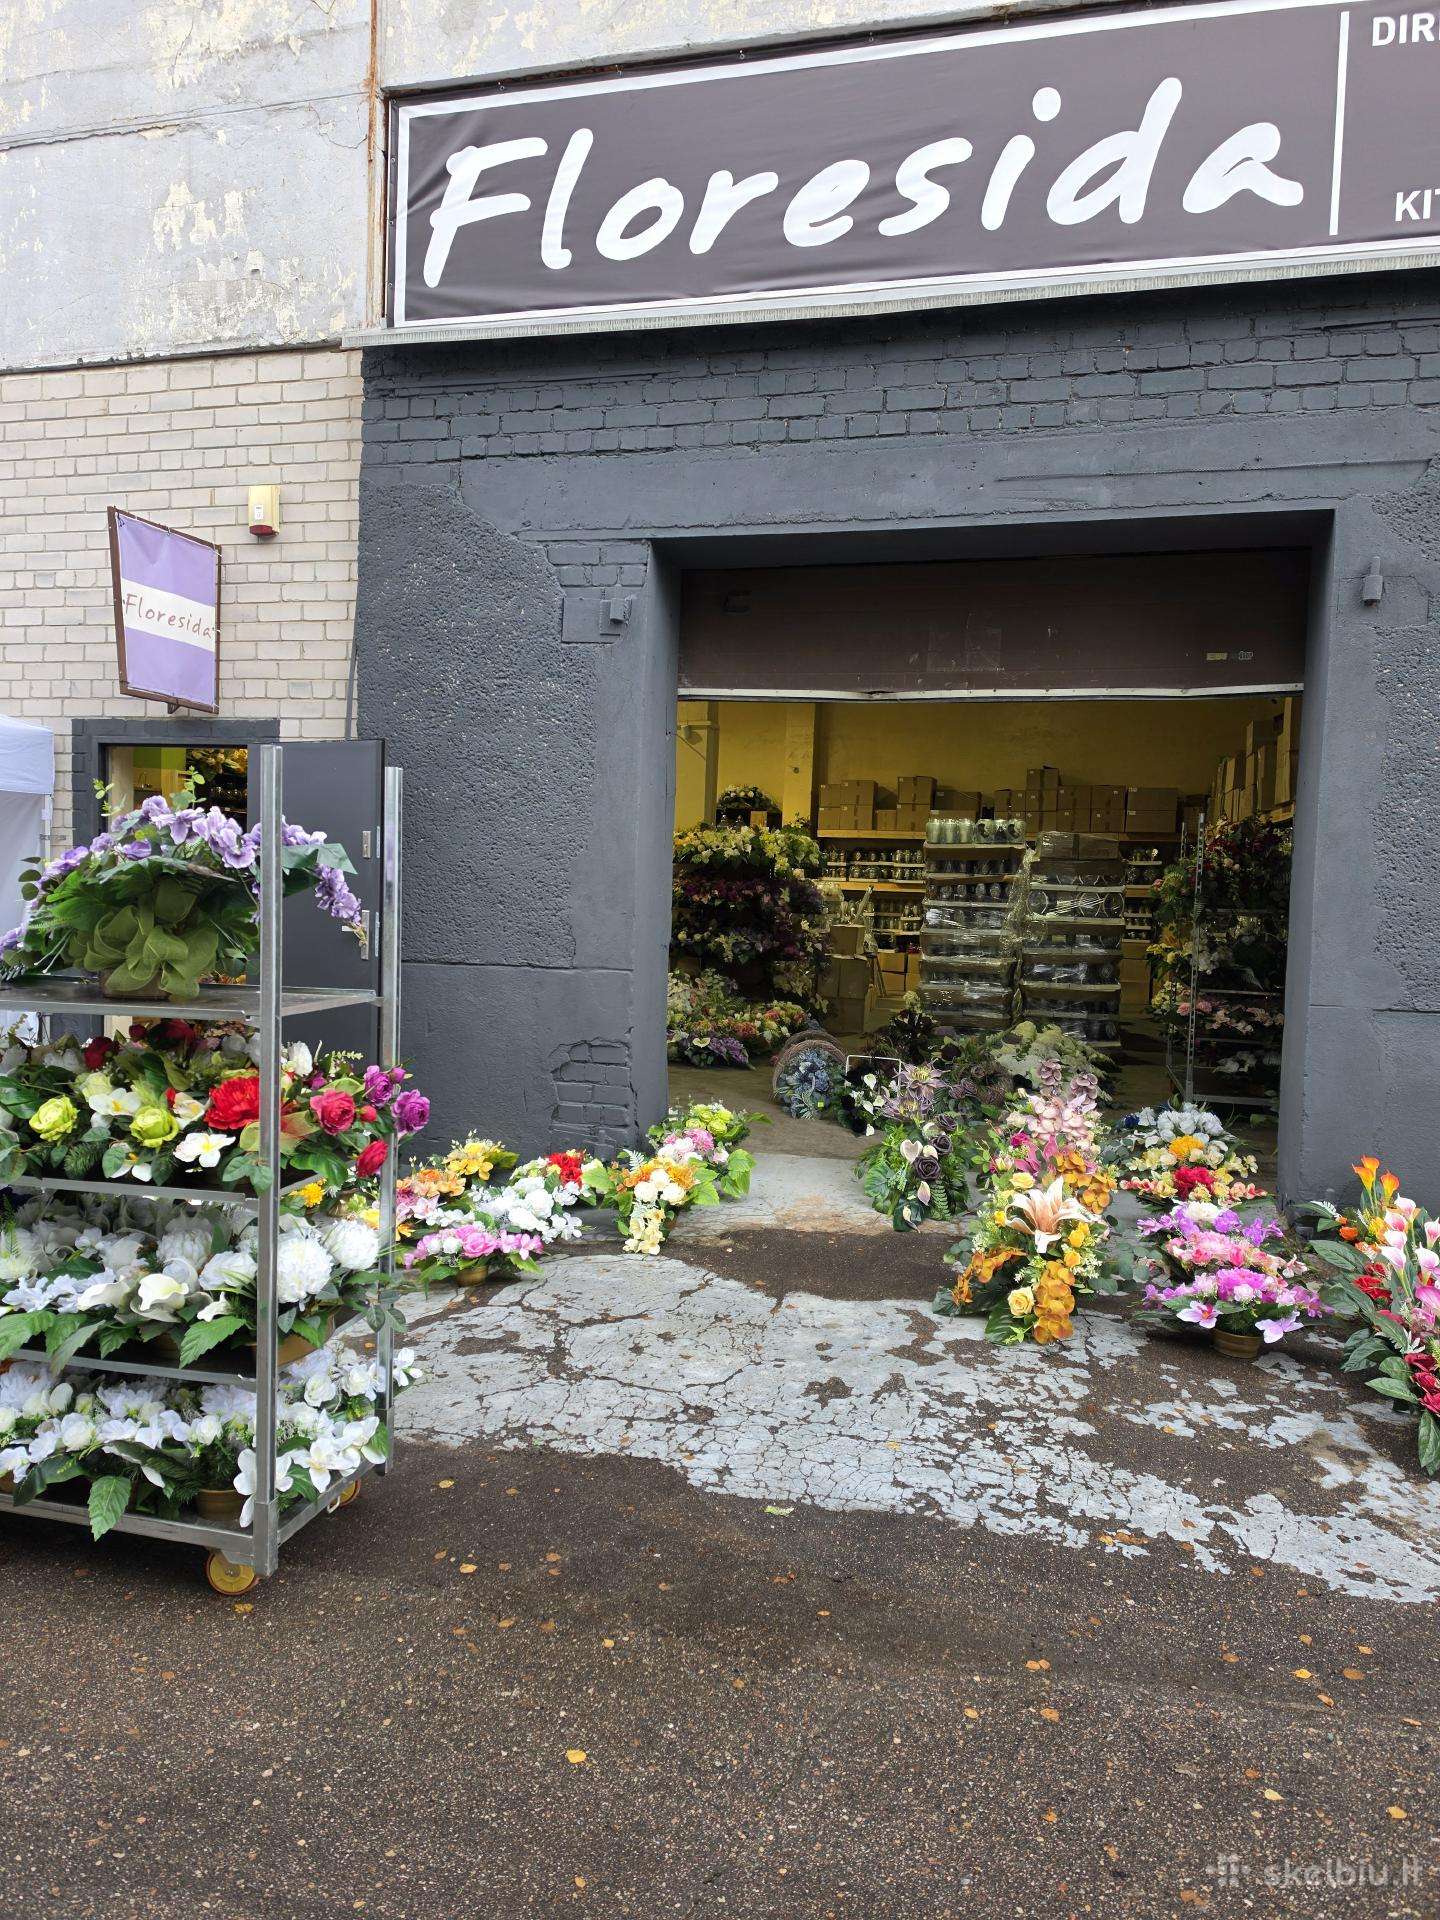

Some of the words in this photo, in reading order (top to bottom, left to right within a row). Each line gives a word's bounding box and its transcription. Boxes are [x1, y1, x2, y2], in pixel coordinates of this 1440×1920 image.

[1371, 12, 1440, 47] DIR
[423, 77, 1304, 289] Floresida
[1395, 188, 1440, 222] KI
[125, 593, 212, 639] Floresida
